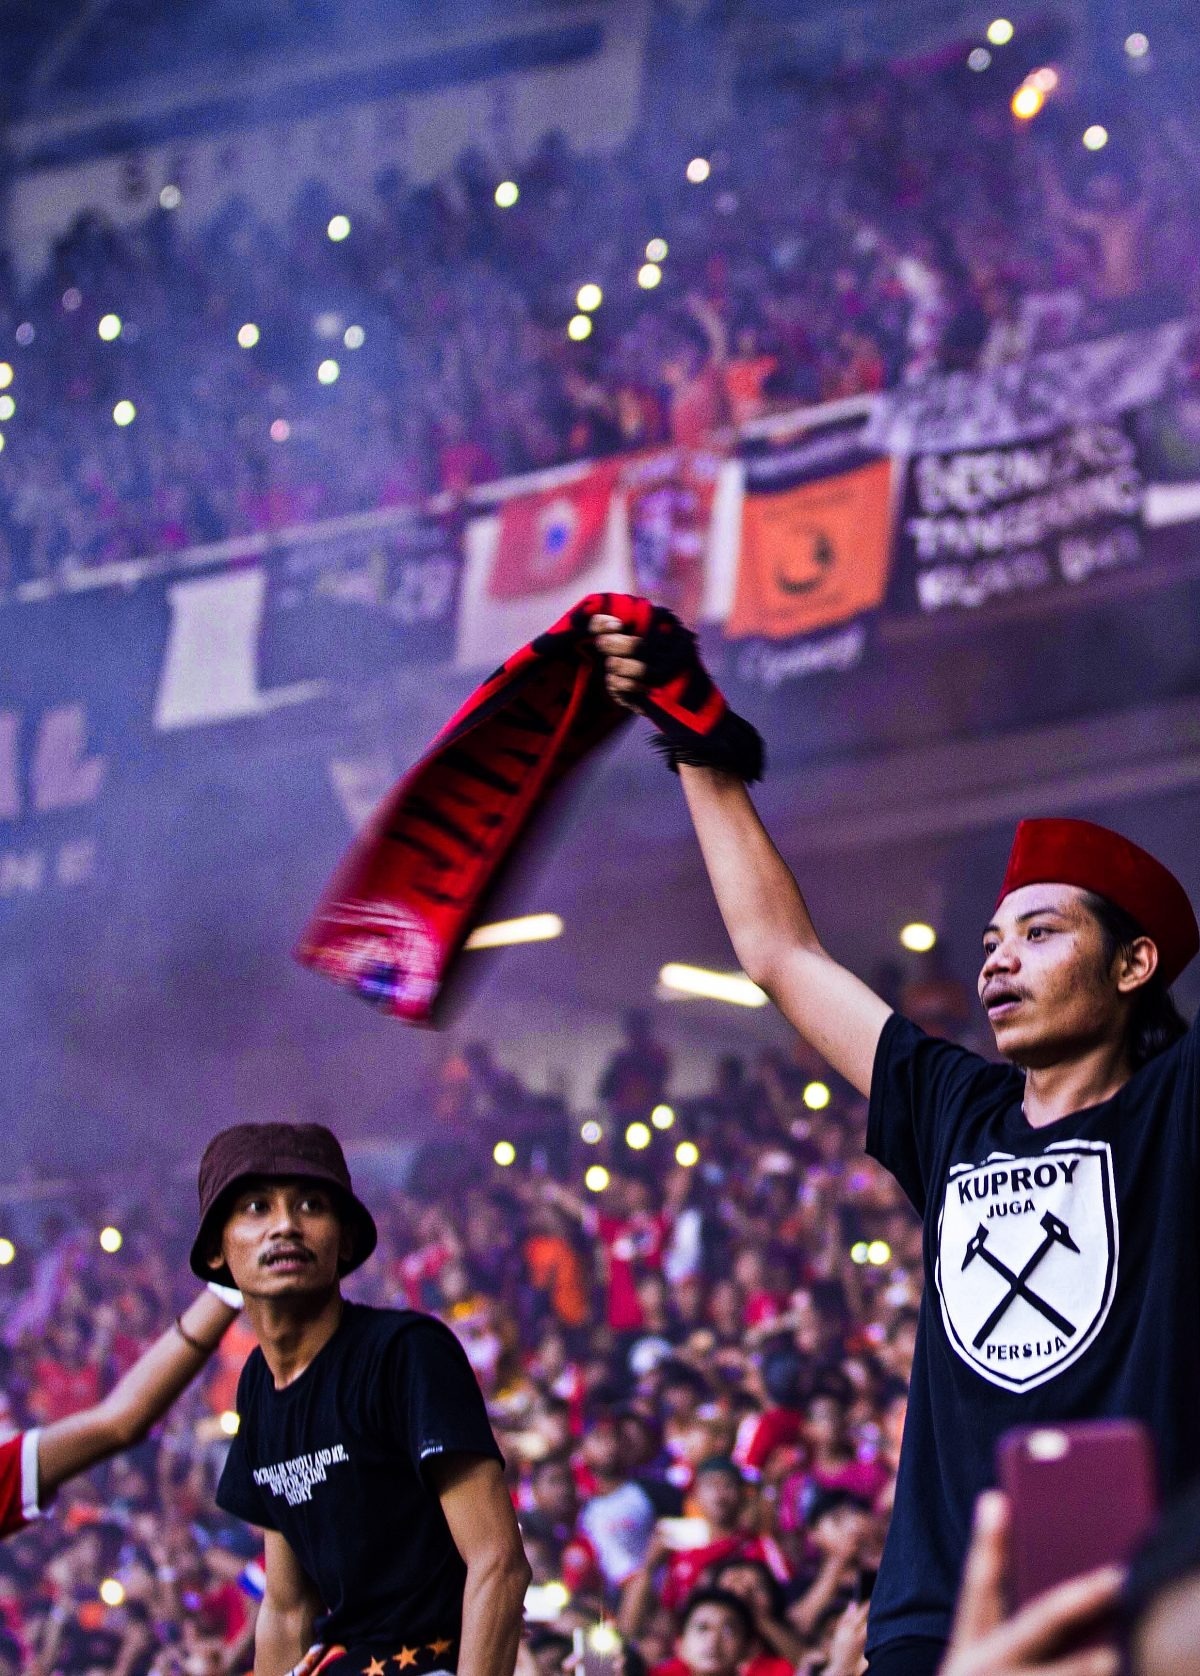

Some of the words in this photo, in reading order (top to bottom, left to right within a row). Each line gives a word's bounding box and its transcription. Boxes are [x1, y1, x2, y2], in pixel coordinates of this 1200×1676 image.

[958, 1159, 1080, 1204] KUPROY
[986, 1199, 1036, 1219] JUGA
[986, 1336, 1067, 1361] PERSIJA
